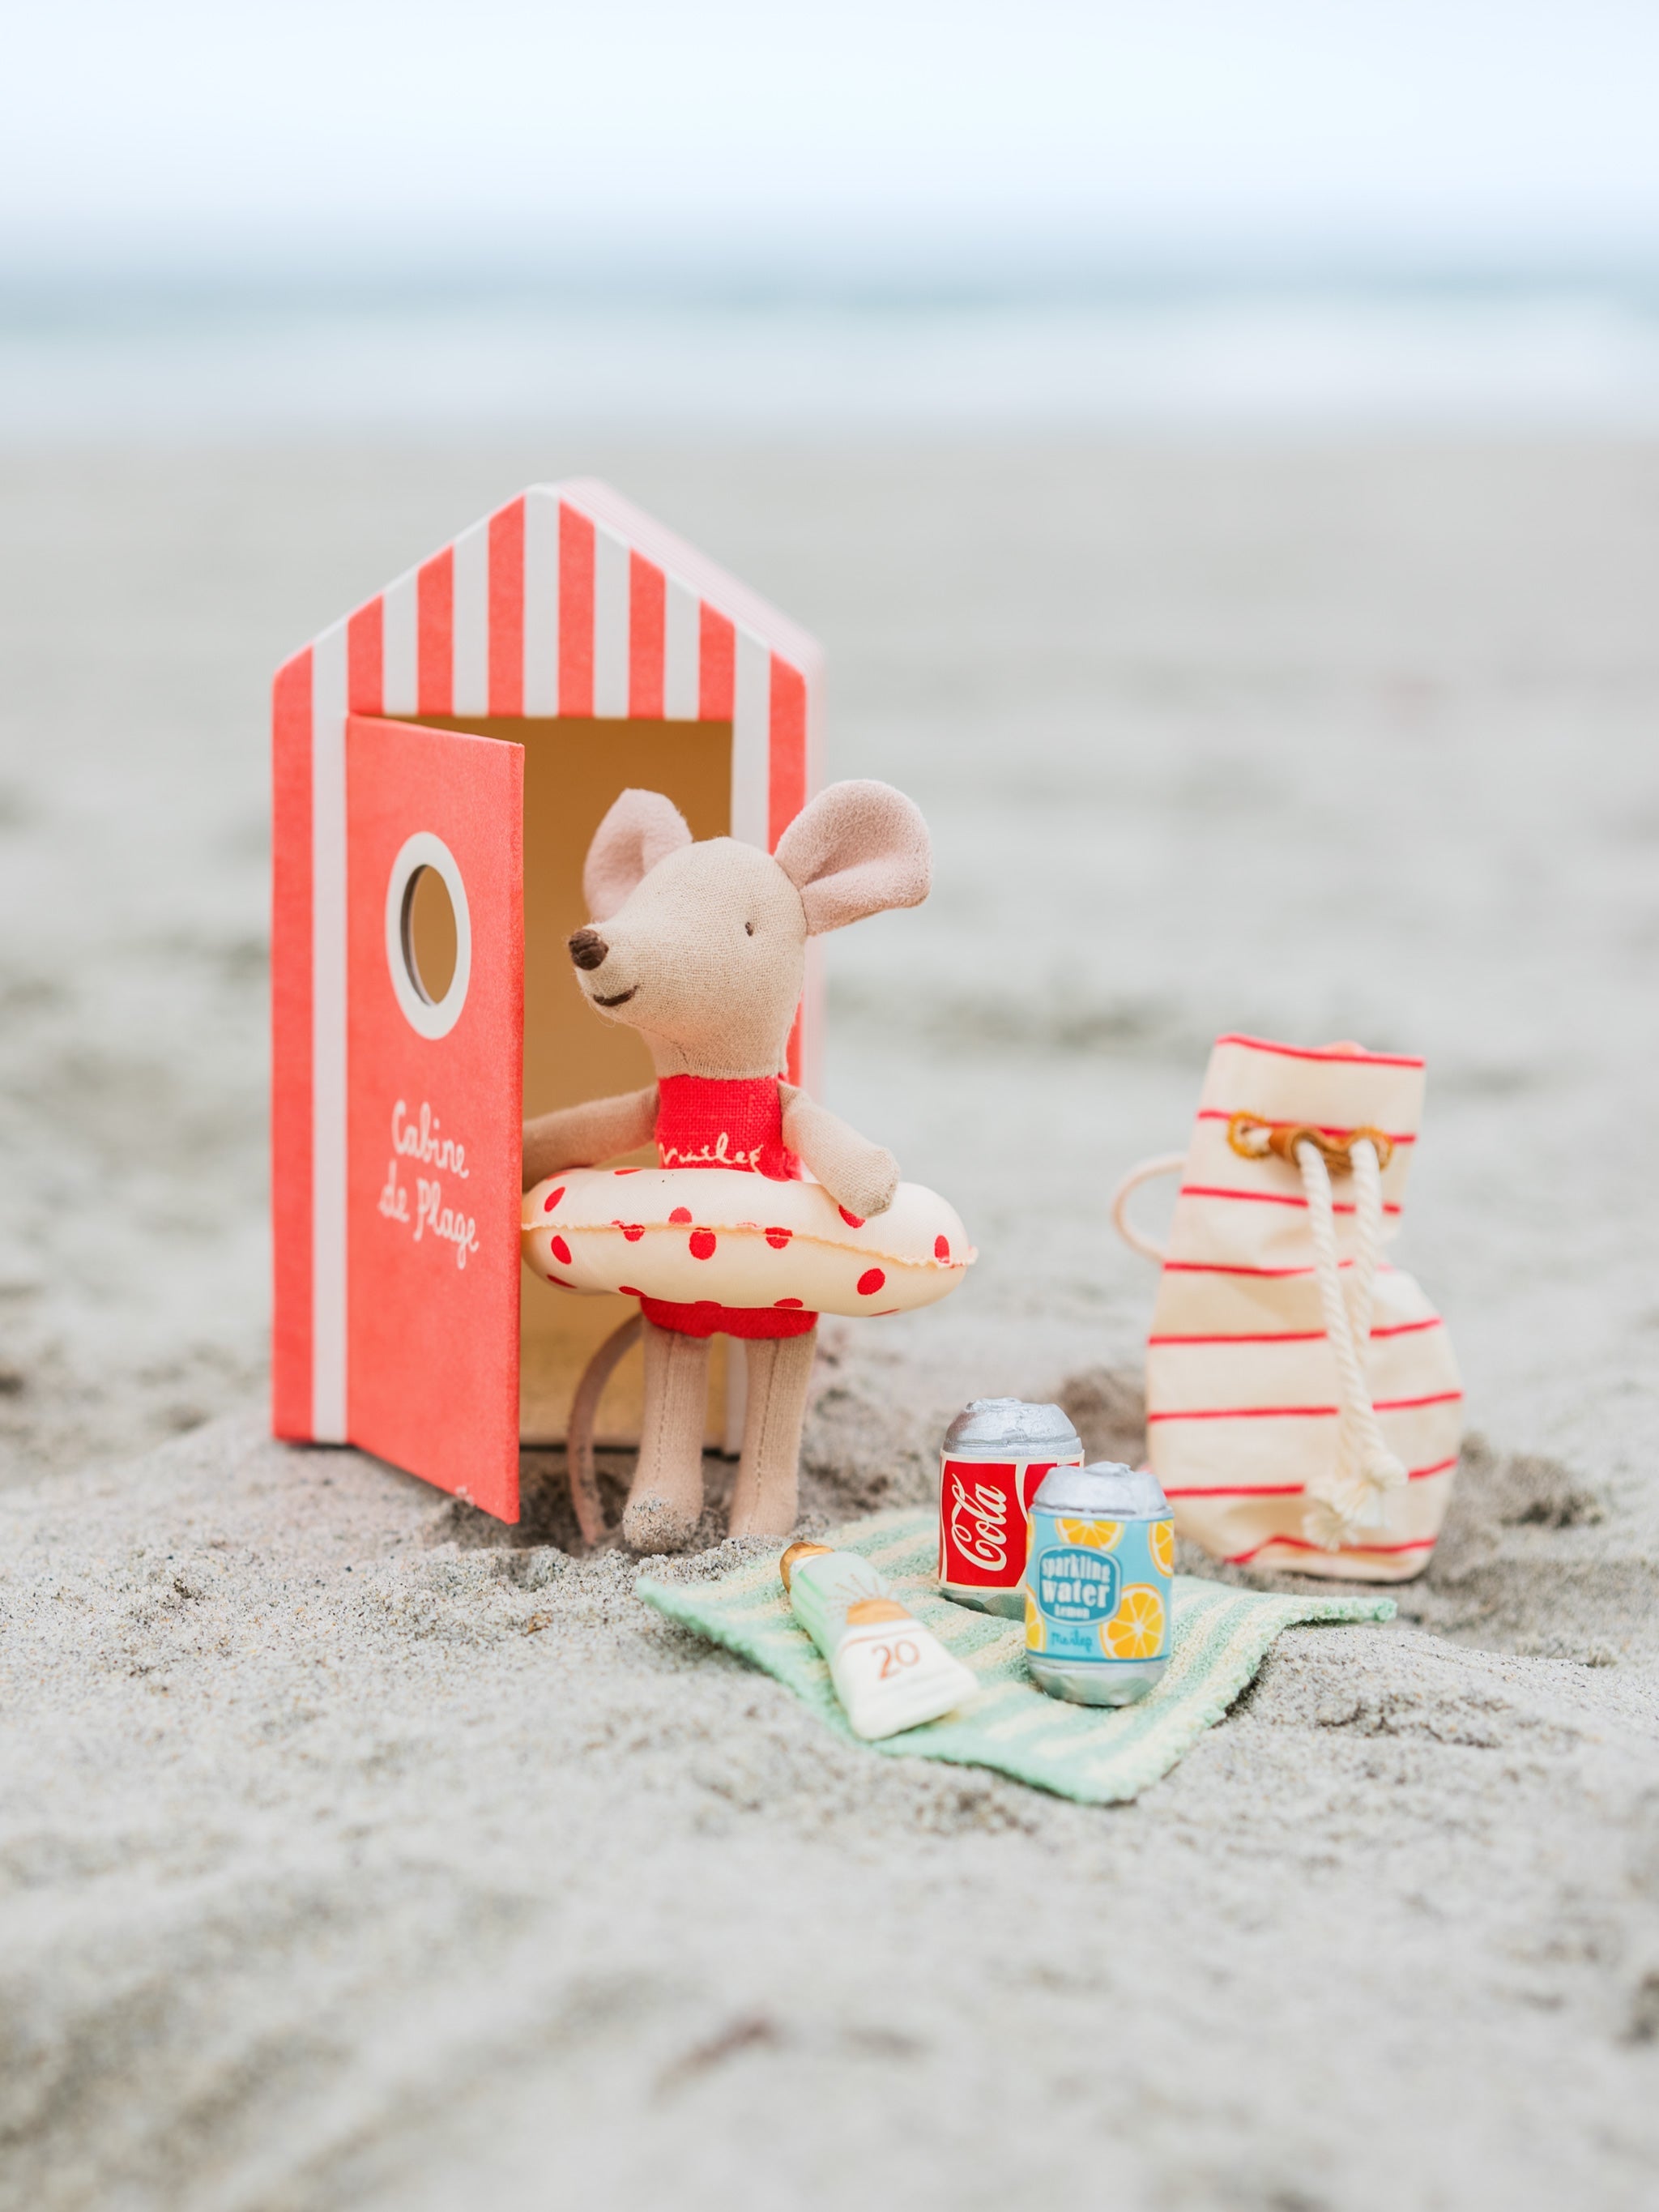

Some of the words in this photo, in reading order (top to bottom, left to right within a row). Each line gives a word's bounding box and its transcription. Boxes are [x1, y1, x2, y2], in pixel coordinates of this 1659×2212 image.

[391, 1100, 470, 1179] Cabine
[377, 1160, 411, 1223] de
[413, 1177, 480, 1270] Plage
[951, 1473, 1008, 1572] Cola
[1041, 1553, 1111, 1584] sparkling
[1041, 1579, 1111, 1609] water
[871, 1638, 921, 1680] 20
